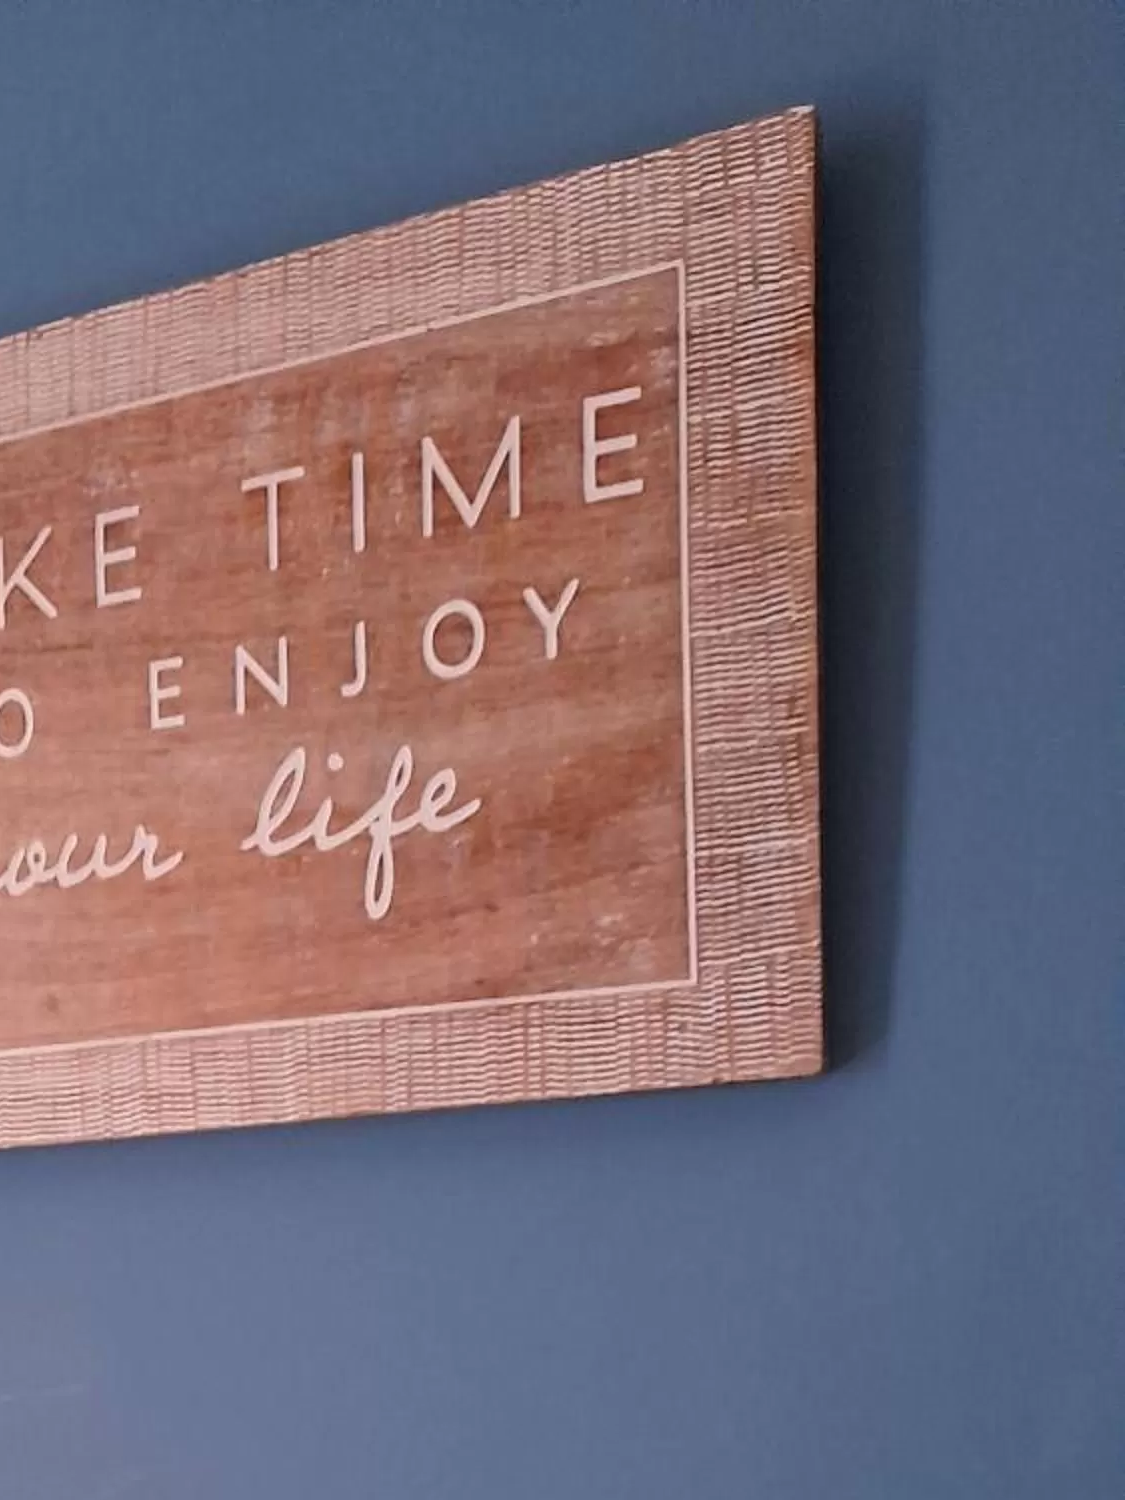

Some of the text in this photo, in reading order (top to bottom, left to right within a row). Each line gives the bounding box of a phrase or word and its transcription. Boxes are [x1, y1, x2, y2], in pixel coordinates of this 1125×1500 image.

[241, 386, 644, 572] TIME
[148, 578, 580, 729] ENJOY
[240, 745, 481, 920] life
